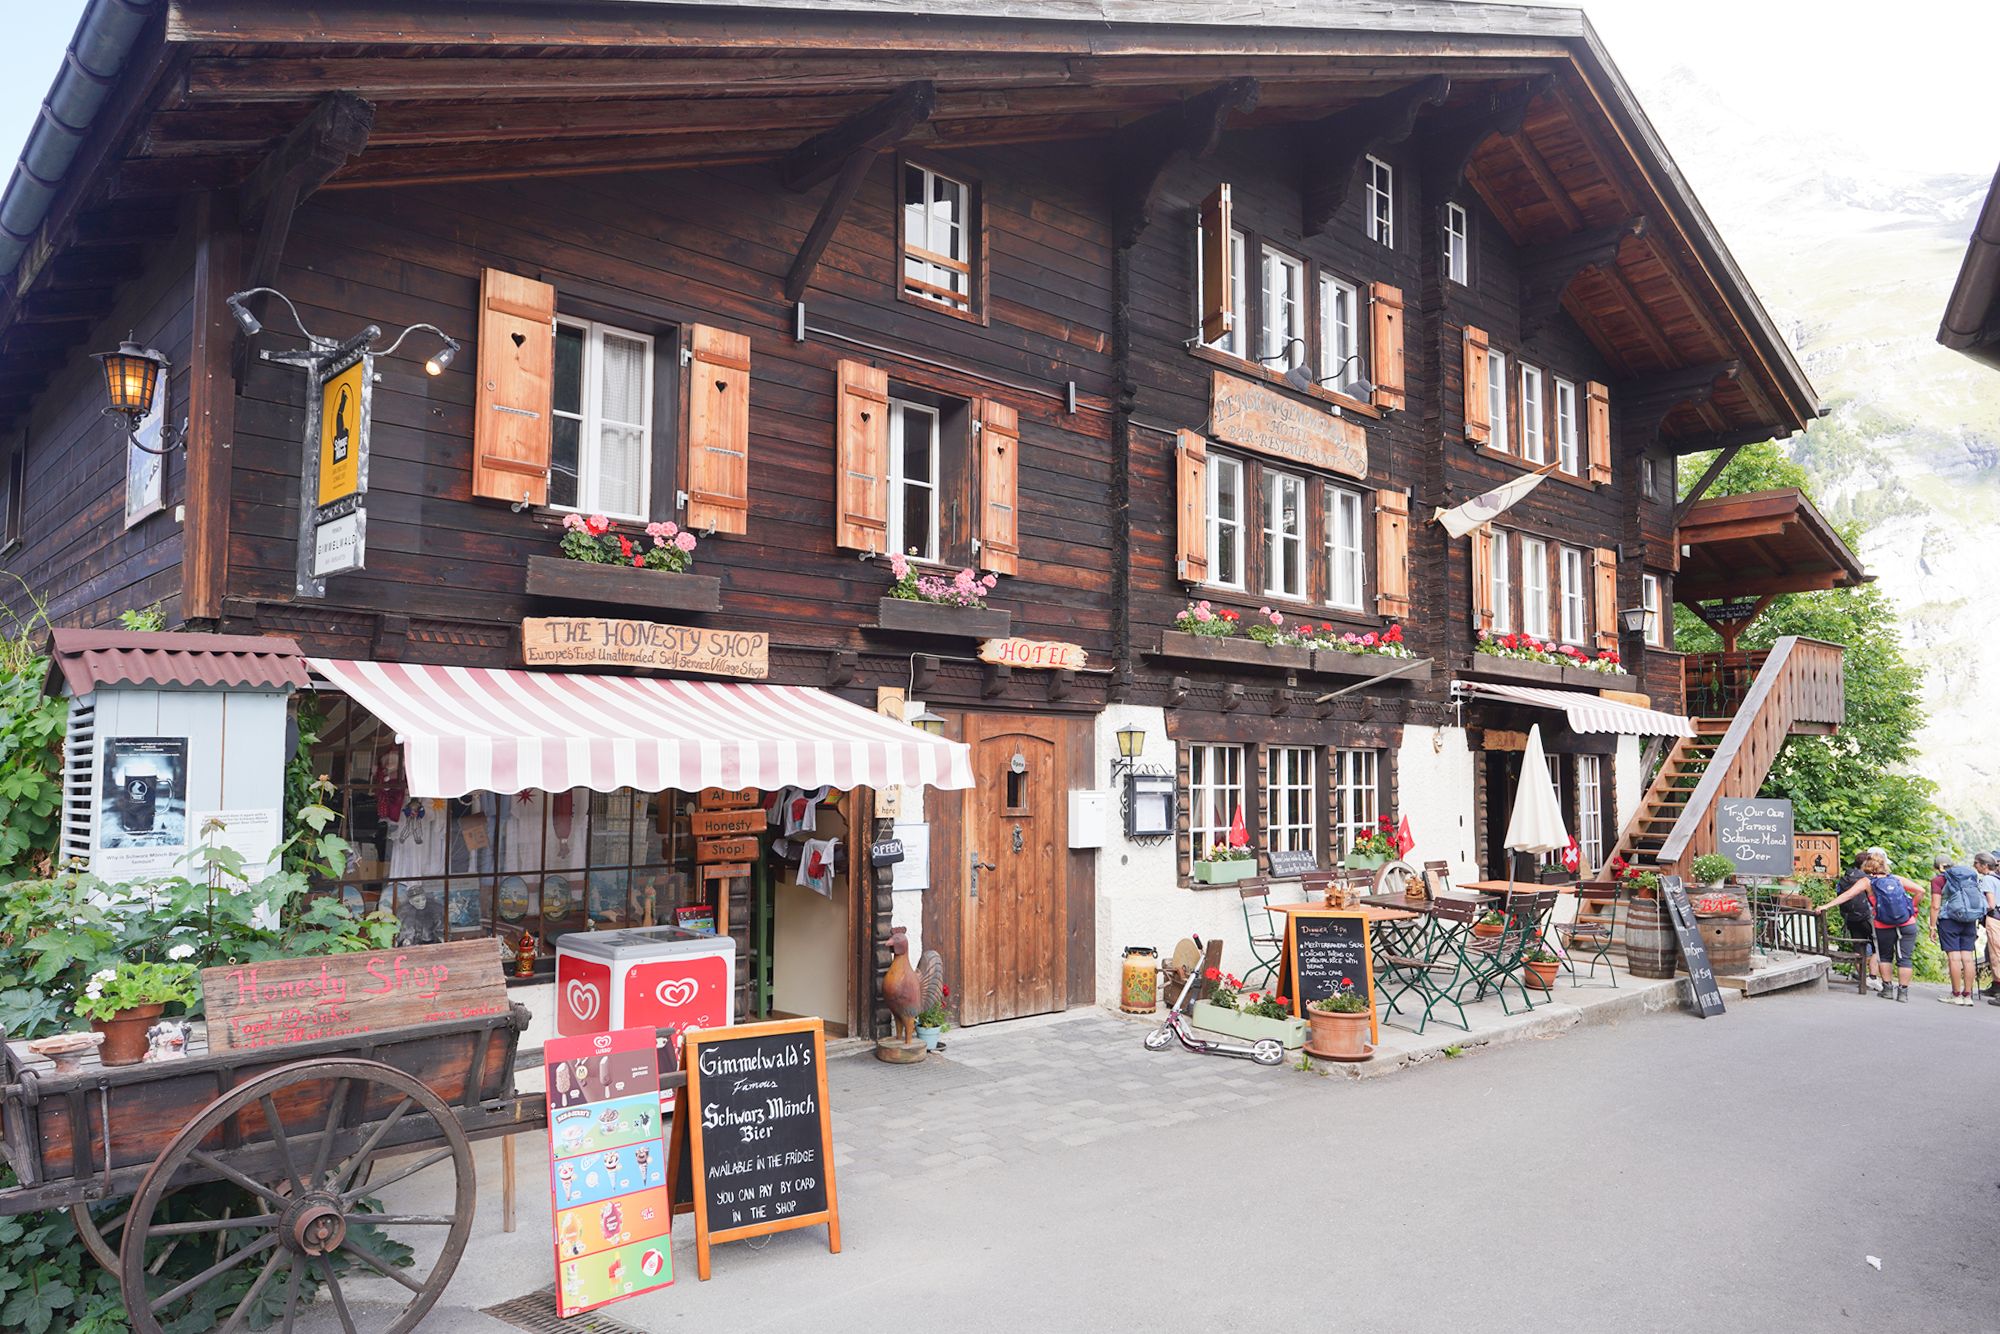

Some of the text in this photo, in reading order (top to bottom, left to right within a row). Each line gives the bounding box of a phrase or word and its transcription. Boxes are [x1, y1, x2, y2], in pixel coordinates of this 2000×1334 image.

[1271, 420, 1307, 442] HOTEL
[544, 621, 763, 658] THE HONESTY SHOP
[526, 647, 765, 678] Europe's First Unattended Self Service Village Shop
[999, 641, 1069, 665] HOTEL
[1723, 804, 1744, 822] Try
[1744, 805, 1764, 817] Our
[705, 820, 752, 832] Honesty
[1722, 827, 1760, 844] Schwarz
[712, 844, 745, 856] Shop!
[1735, 844, 1772, 861] Beer
[225, 955, 449, 1009] Honesty Shop
[699, 1043, 811, 1076] Gimmelwald's
[731, 1077, 778, 1095] Famous
[702, 1094, 815, 1129] Schwarz Mönch
[739, 1125, 774, 1142] Bier
[708, 1160, 753, 1179] AVAILABLE
[767, 1153, 783, 1168] THE
[785, 1149, 815, 1166] FRIDGE
[716, 1177, 816, 1205] YOU CAN PAY BY CARD
[750, 1204, 767, 1219] THE
[775, 1200, 797, 1215] SHOP
